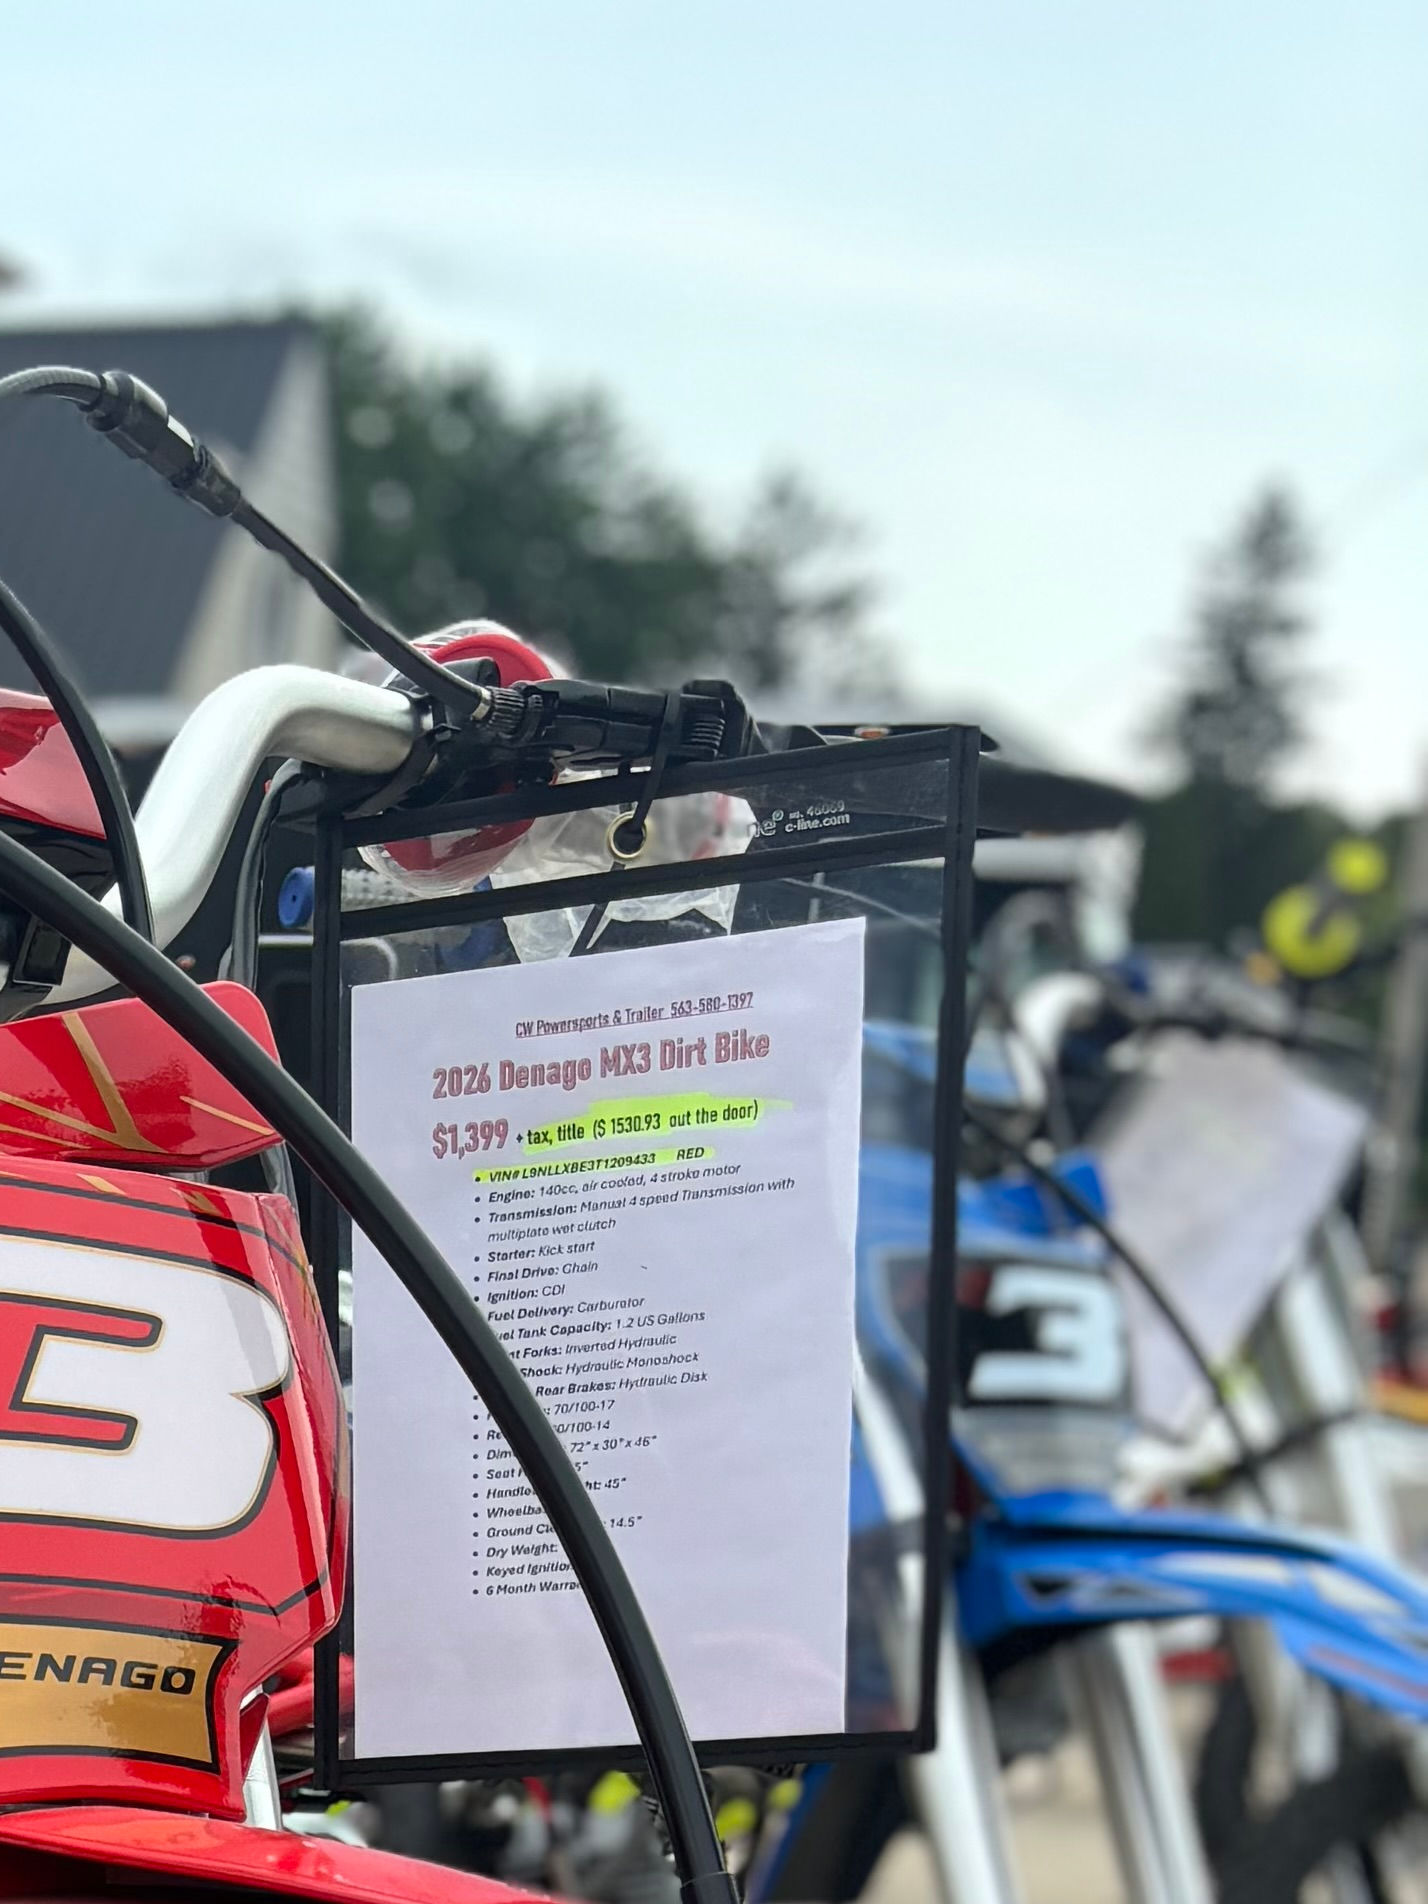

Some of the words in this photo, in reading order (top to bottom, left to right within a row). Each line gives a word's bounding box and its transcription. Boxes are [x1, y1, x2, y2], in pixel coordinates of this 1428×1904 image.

[785, 814, 850, 832] c-line.com
[516, 1021, 534, 1037] CW
[536, 1011, 610, 1036] Powersports
[613, 1012, 622, 1025] &
[626, 1006, 664, 1024] Trailer
[432, 1062, 491, 1099] 2026
[499, 1057, 592, 1091] Denago
[600, 1042, 652, 1078] MX3
[659, 1037, 707, 1071] Dirt
[715, 1028, 770, 1063] Bike
[432, 1118, 509, 1160] $1,399
[527, 1128, 553, 1146] tax,
[557, 1122, 585, 1141] title
[593, 1119, 606, 1139] ($
[611, 1113, 661, 1135] 1530.93
[669, 1109, 693, 1129] out
[696, 1107, 717, 1125] the
[722, 1100, 759, 1124] door)
[677, 1147, 705, 1160] RED
[489, 1189, 535, 1203] Engine:
[540, 1184, 578, 1197] 140cc,
[582, 1181, 599, 1192] air
[650, 1173, 657, 1182] 4
[660, 1168, 699, 1182] stroke
[703, 1165, 741, 1177] motor
[489, 1204, 577, 1223] Transmission:
[581, 1197, 626, 1212] Manual
[629, 1196, 636, 1206] 4
[639, 1191, 678, 1208] speed
[682, 1182, 764, 1201] Transmission
[767, 1177, 795, 1190] with
[488, 1225, 548, 1242] multiplate
[577, 1217, 616, 1232] clutch
[488, 1250, 535, 1263] Starter:
[538, 1245, 564, 1257] Kick
[567, 1241, 595, 1252] start
[488, 1268, 519, 1282] Final
[521, 1266, 559, 1279] Drive:
[562, 1261, 598, 1274] Chain
[487, 1288, 538, 1304] Ignition:
[542, 1284, 565, 1297] CDI
[488, 1310, 514, 1322] Fuel
[517, 1305, 574, 1320] Delivery:
[518, 1328, 546, 1339] Tank
[550, 1321, 612, 1337] Capacity:
[617, 1319, 634, 1329] 1.2
[637, 1315, 654, 1326] US
[658, 1312, 705, 1325] Gallons
[522, 1346, 562, 1359] Forks:
[566, 1339, 615, 1354] Inverted
[618, 1335, 677, 1351] Hydraulic
[566, 1360, 624, 1376] Hydraulic
[626, 1352, 700, 1368] Monoshock
[536, 1386, 565, 1397] Rear
[568, 1381, 615, 1395] Brakes:
[619, 1375, 677, 1391] Hydraulic
[681, 1371, 708, 1384] Disk
[554, 1400, 615, 1415] 70/100-17
[553, 1420, 610, 1433] 0/100-14
[486, 1469, 515, 1480] Seat
[486, 1505, 542, 1519] Wheelba
[486, 1524, 532, 1538] Ground
[486, 1547, 508, 1559] Dry
[511, 1543, 558, 1556] Weight:
[486, 1565, 524, 1577] Keyed
[486, 1586, 493, 1595] 6
[496, 1582, 535, 1595] Month
[540, 1581, 581, 1592] Warra
